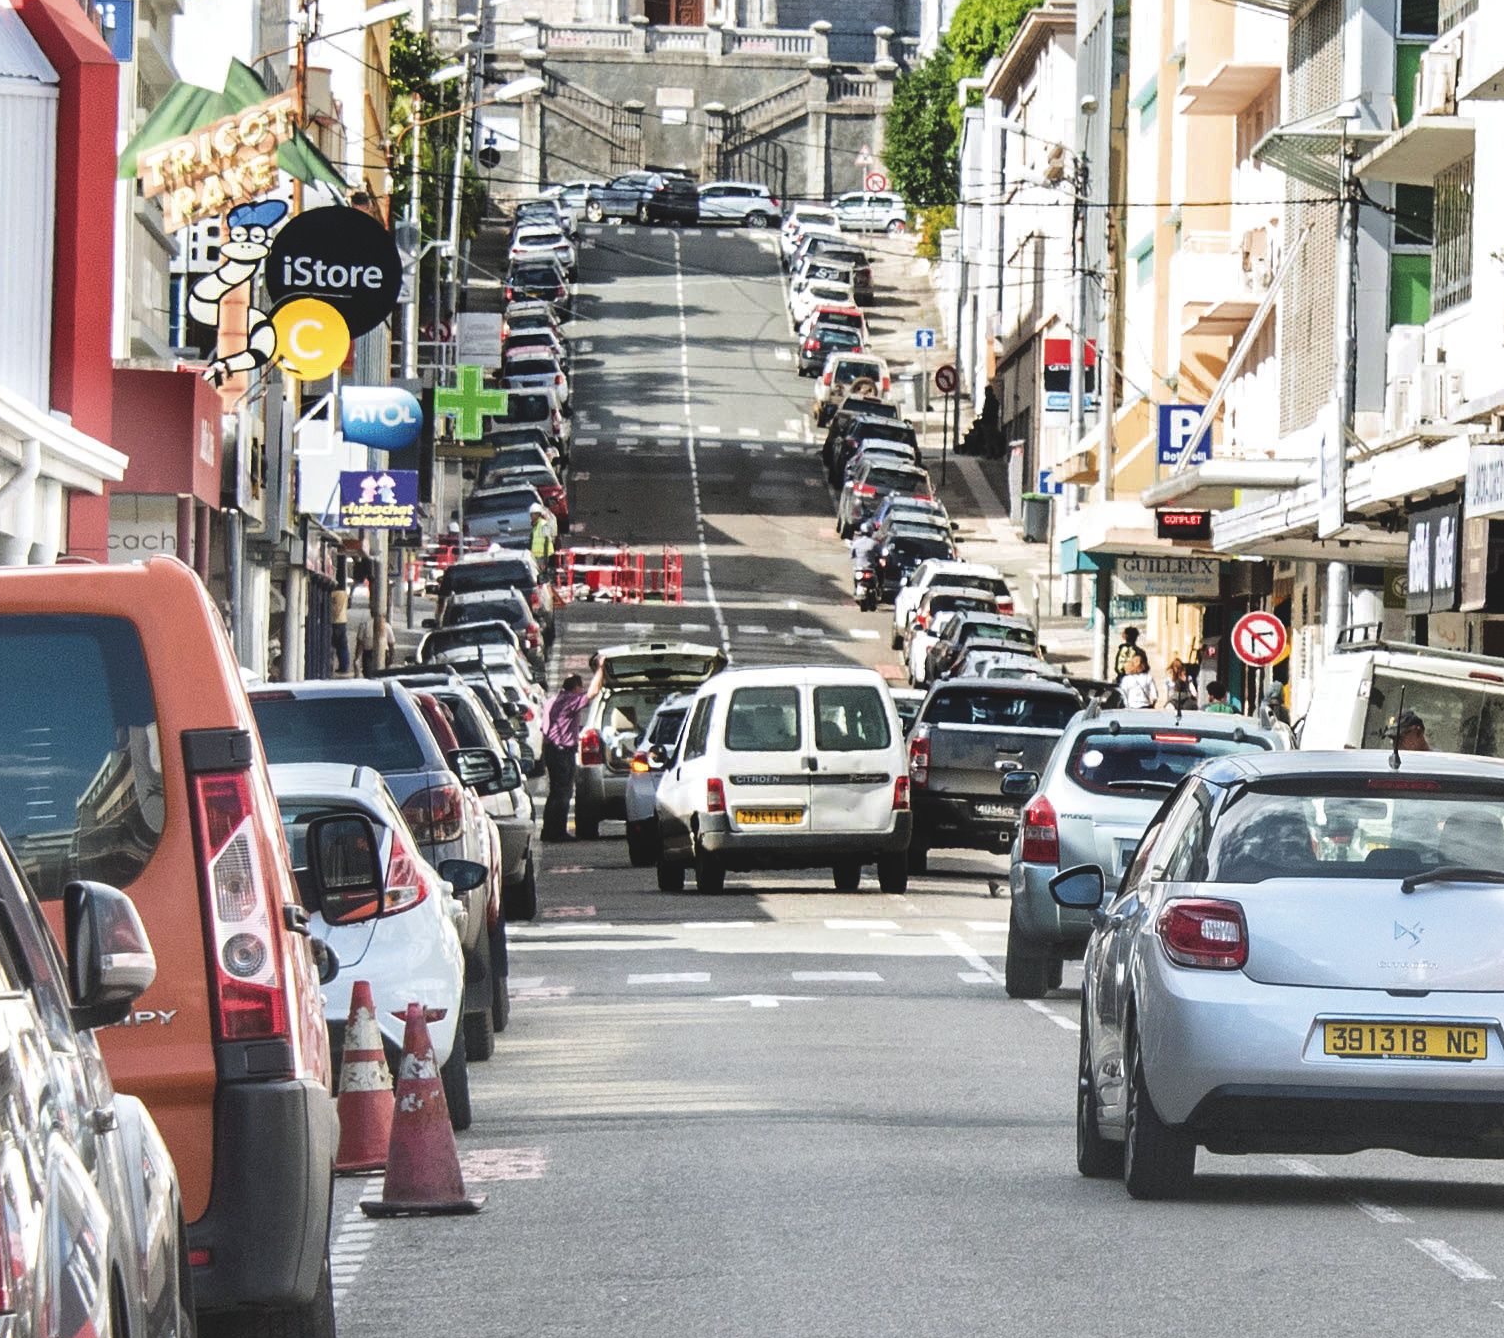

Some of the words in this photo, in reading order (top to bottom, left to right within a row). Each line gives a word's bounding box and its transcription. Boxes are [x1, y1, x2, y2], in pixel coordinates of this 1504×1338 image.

[145, 97, 294, 188] TRICOT
[283, 256, 383, 289] iStore
[349, 404, 417, 428] ATOL
[1170, 409, 1202, 449] P
[1163, 514, 1202, 526] COMPLET
[107, 531, 195, 551] cach
[1123, 562, 1215, 575] GUILLEUX
[1332, 1027, 1427, 1052] 391318
[1447, 1030, 1478, 1054] NC
